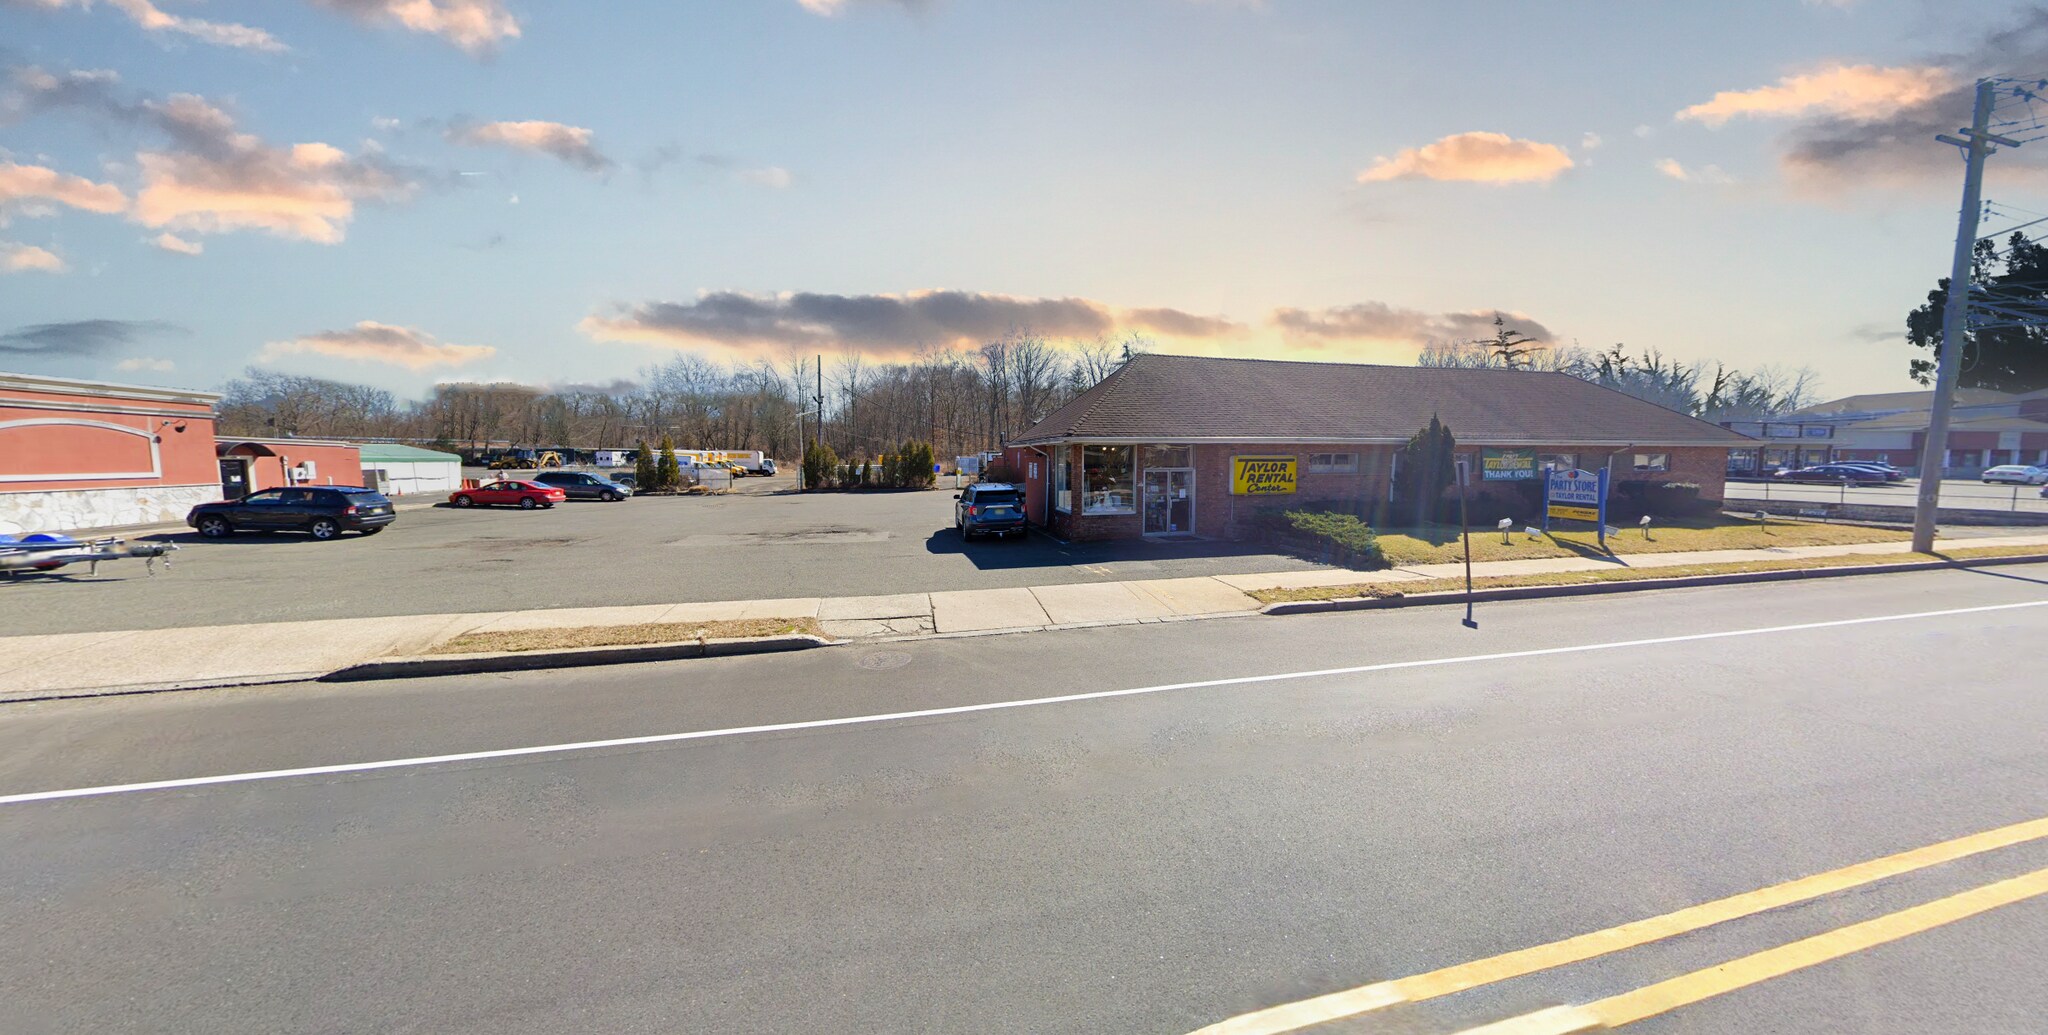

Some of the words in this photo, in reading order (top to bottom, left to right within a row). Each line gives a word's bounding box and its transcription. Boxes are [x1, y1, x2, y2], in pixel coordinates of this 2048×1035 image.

[1238, 458, 1295, 480] TAYLOR
[1484, 470, 1512, 478] THANK
[1514, 470, 1534, 478] YOU!
[1247, 473, 1293, 483] RENTAL
[1247, 483, 1287, 493] Center
[1550, 479, 1573, 491] PARTY
[1573, 479, 1597, 493] STORE
[1555, 492, 1575, 500] TAYLOR
[1575, 493, 1597, 502] RENTAL
